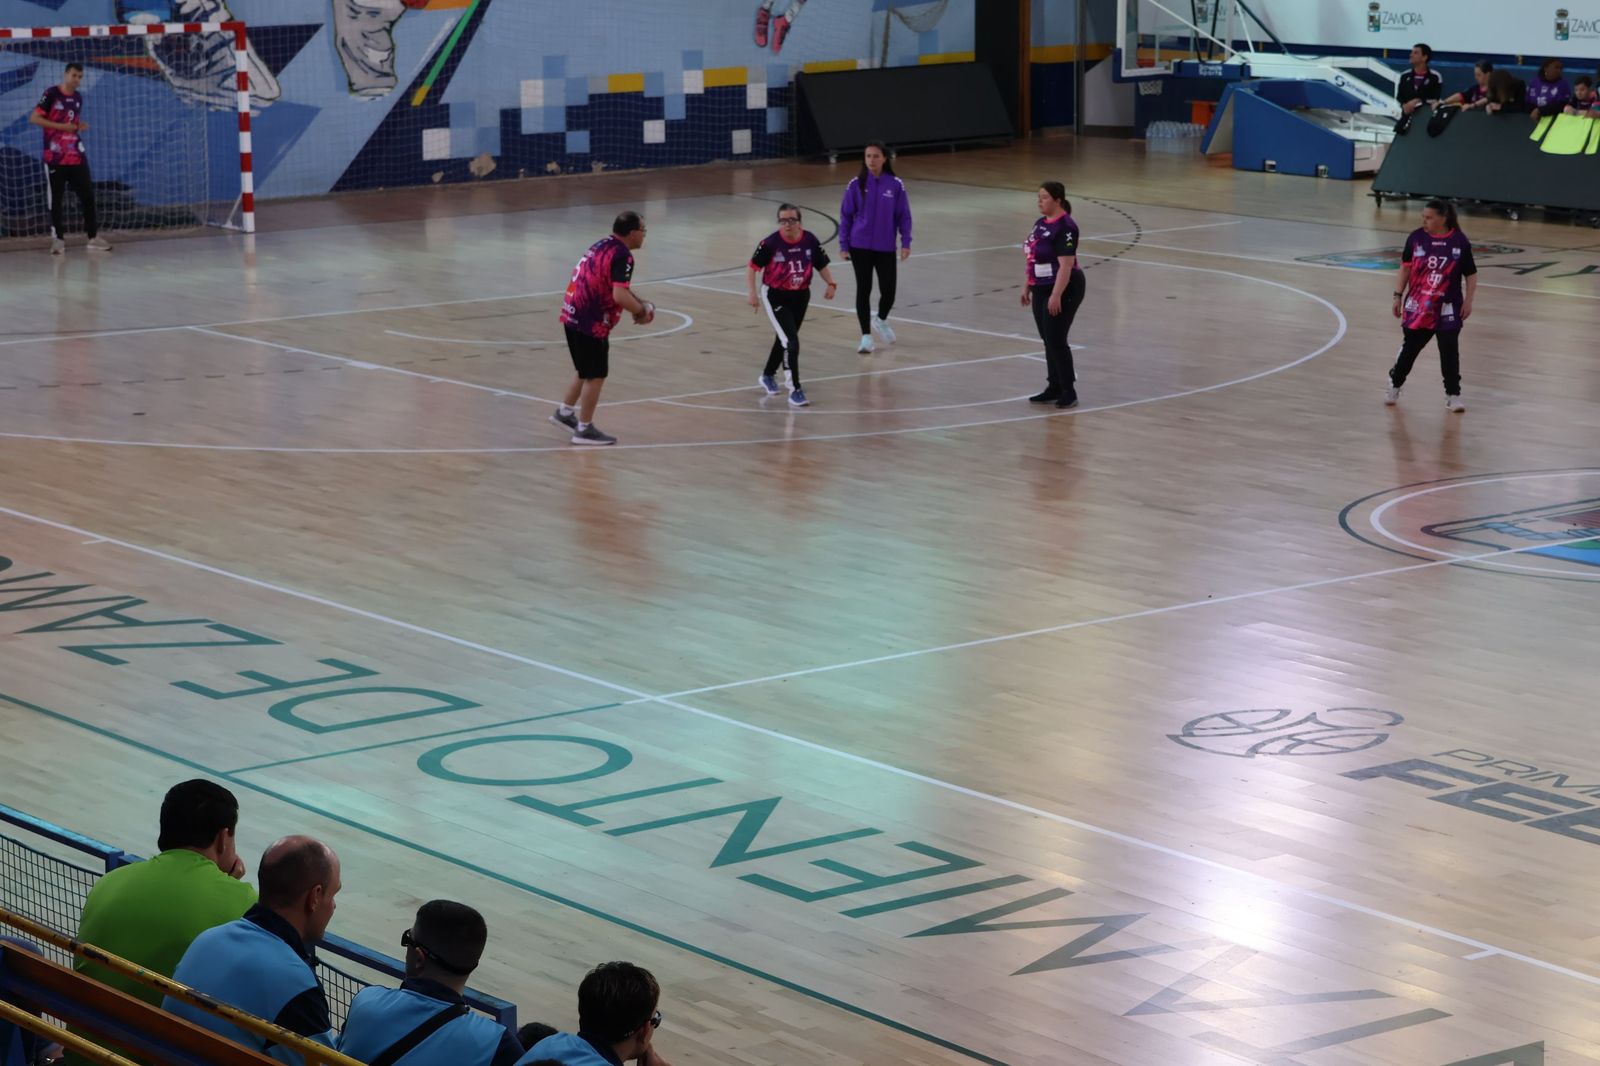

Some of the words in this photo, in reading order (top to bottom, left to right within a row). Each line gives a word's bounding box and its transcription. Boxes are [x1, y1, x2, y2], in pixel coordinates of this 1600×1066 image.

[1382, 11, 1424, 26] ZAMORA
[68, 110, 75, 120] 9
[788, 260, 804, 273] 11
[1427, 255, 1448, 269] 87
[170, 658, 483, 734] DE
[1430, 748, 1600, 798] PRIM
